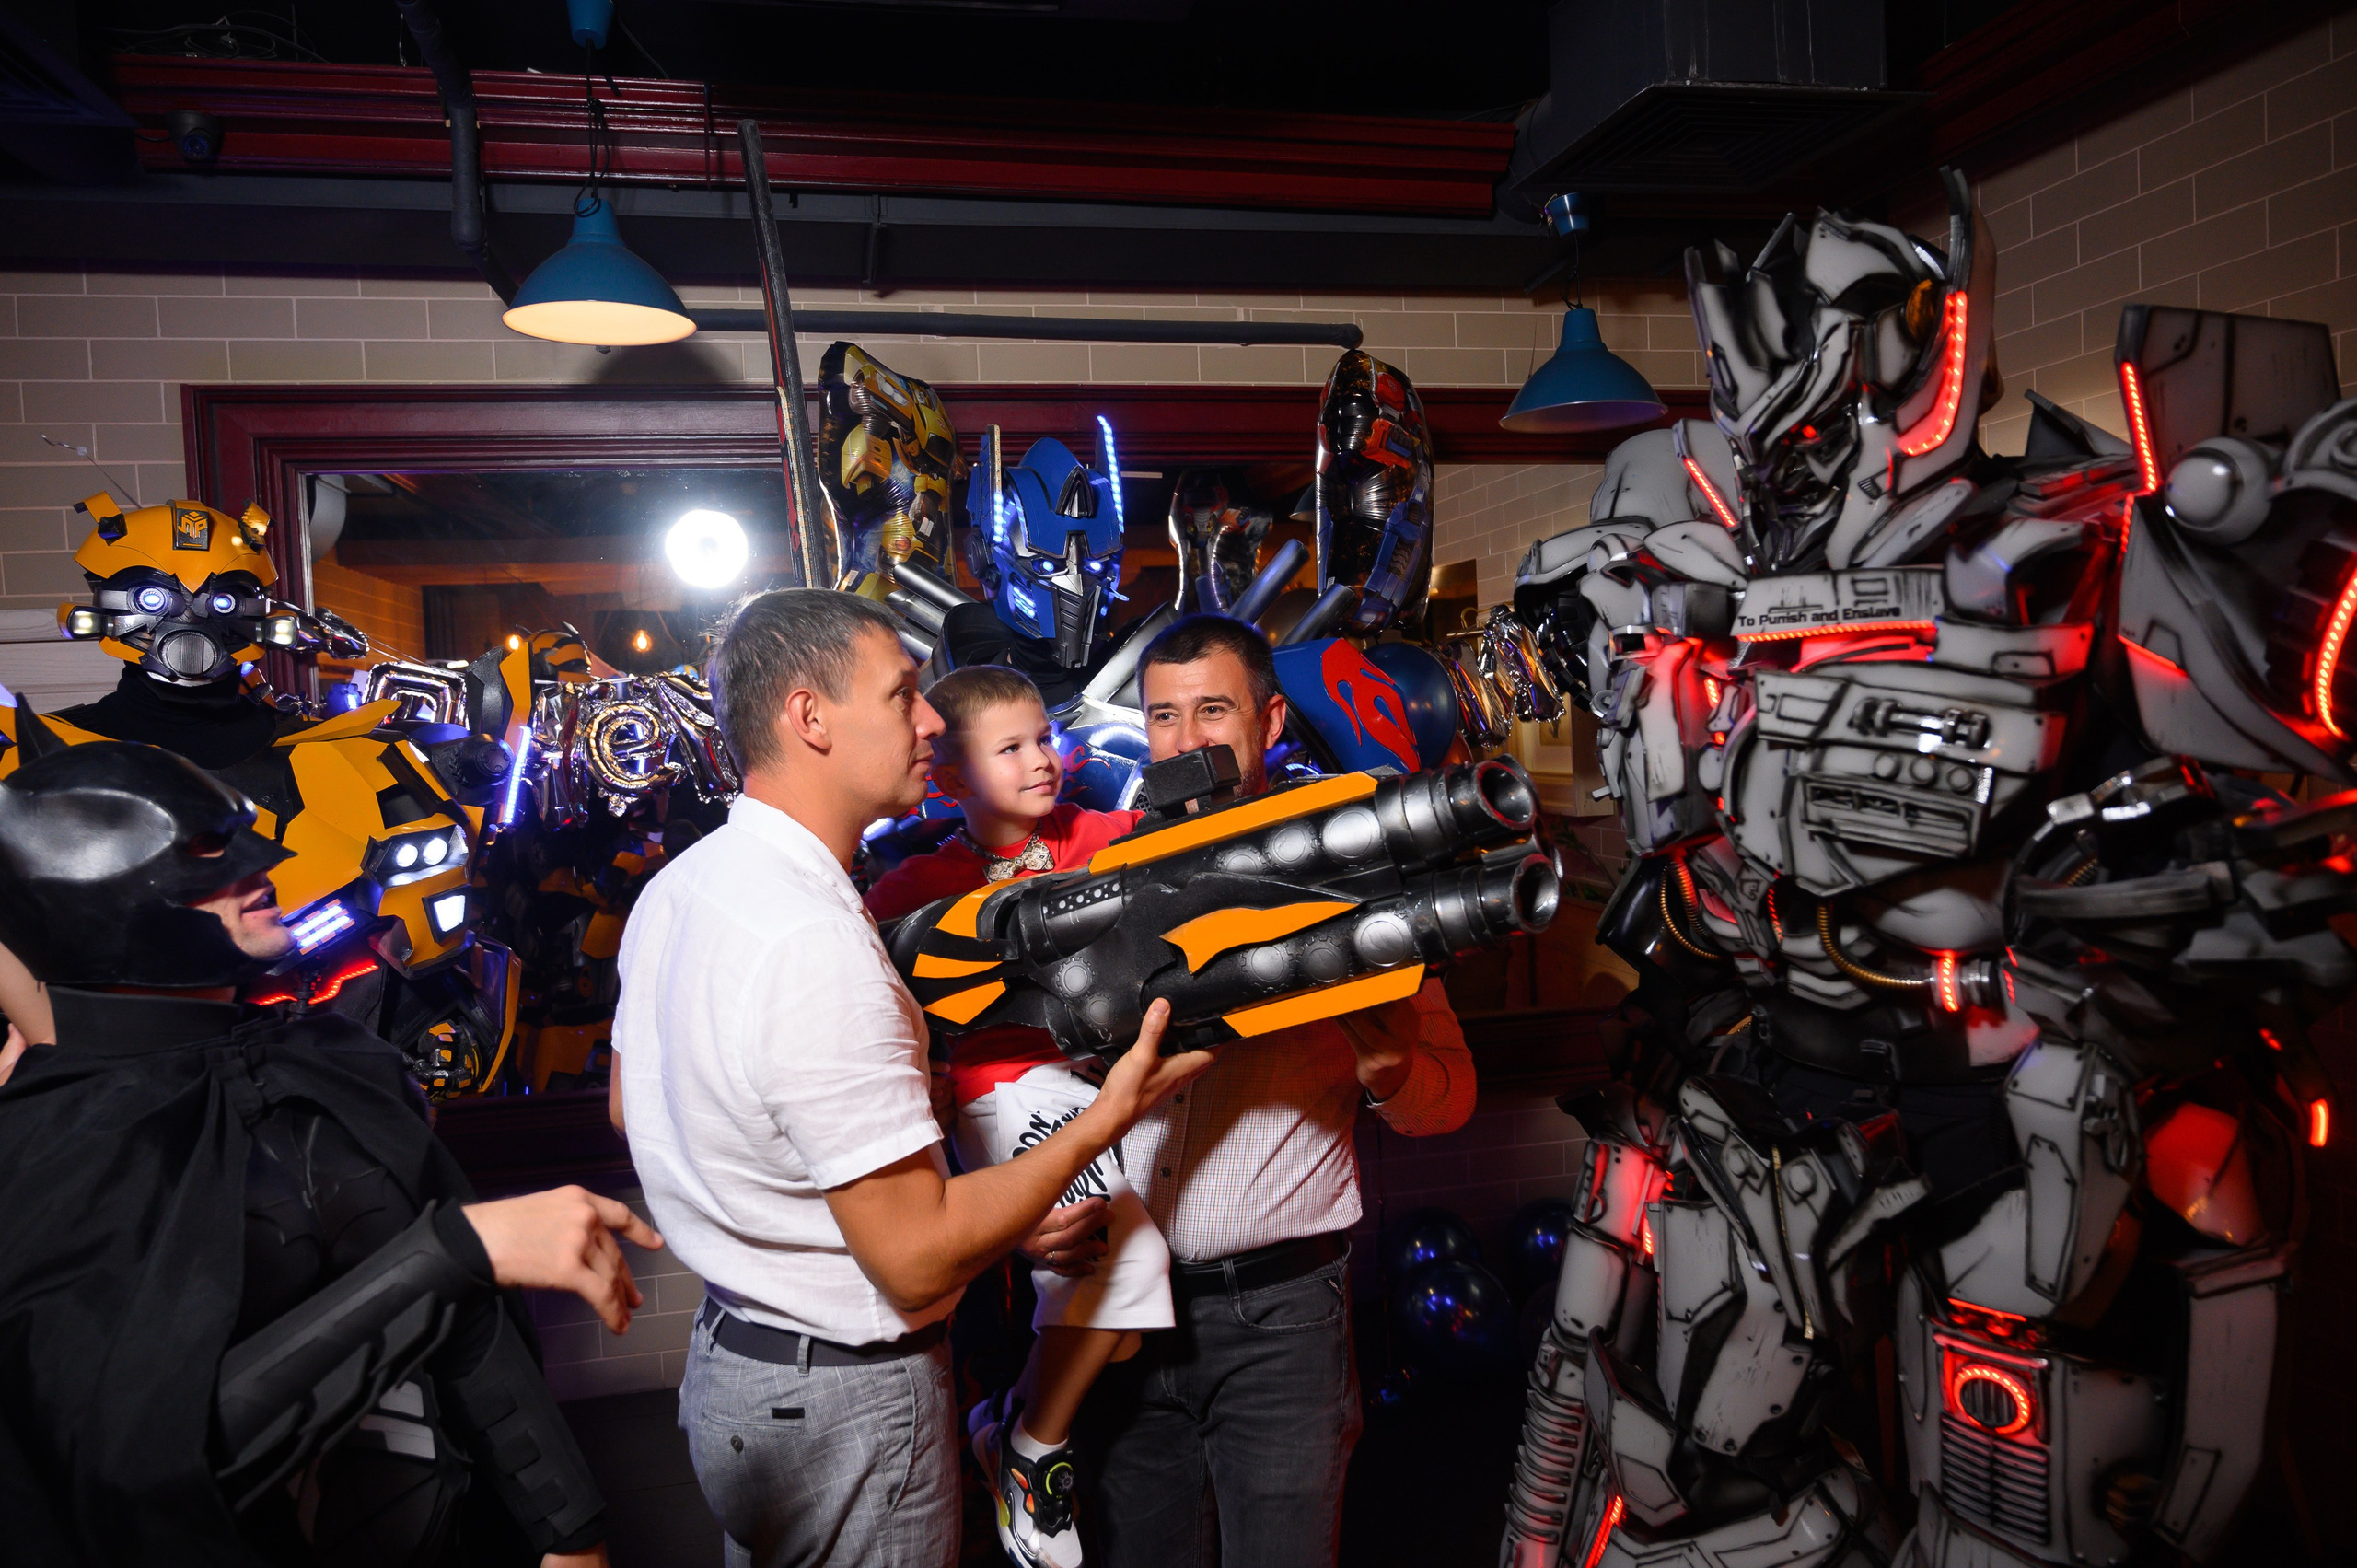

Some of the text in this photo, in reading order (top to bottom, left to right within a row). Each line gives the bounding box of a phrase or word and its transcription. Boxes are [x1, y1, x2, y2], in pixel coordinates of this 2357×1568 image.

[1738, 606, 1901, 627] To Punish and Enslave
